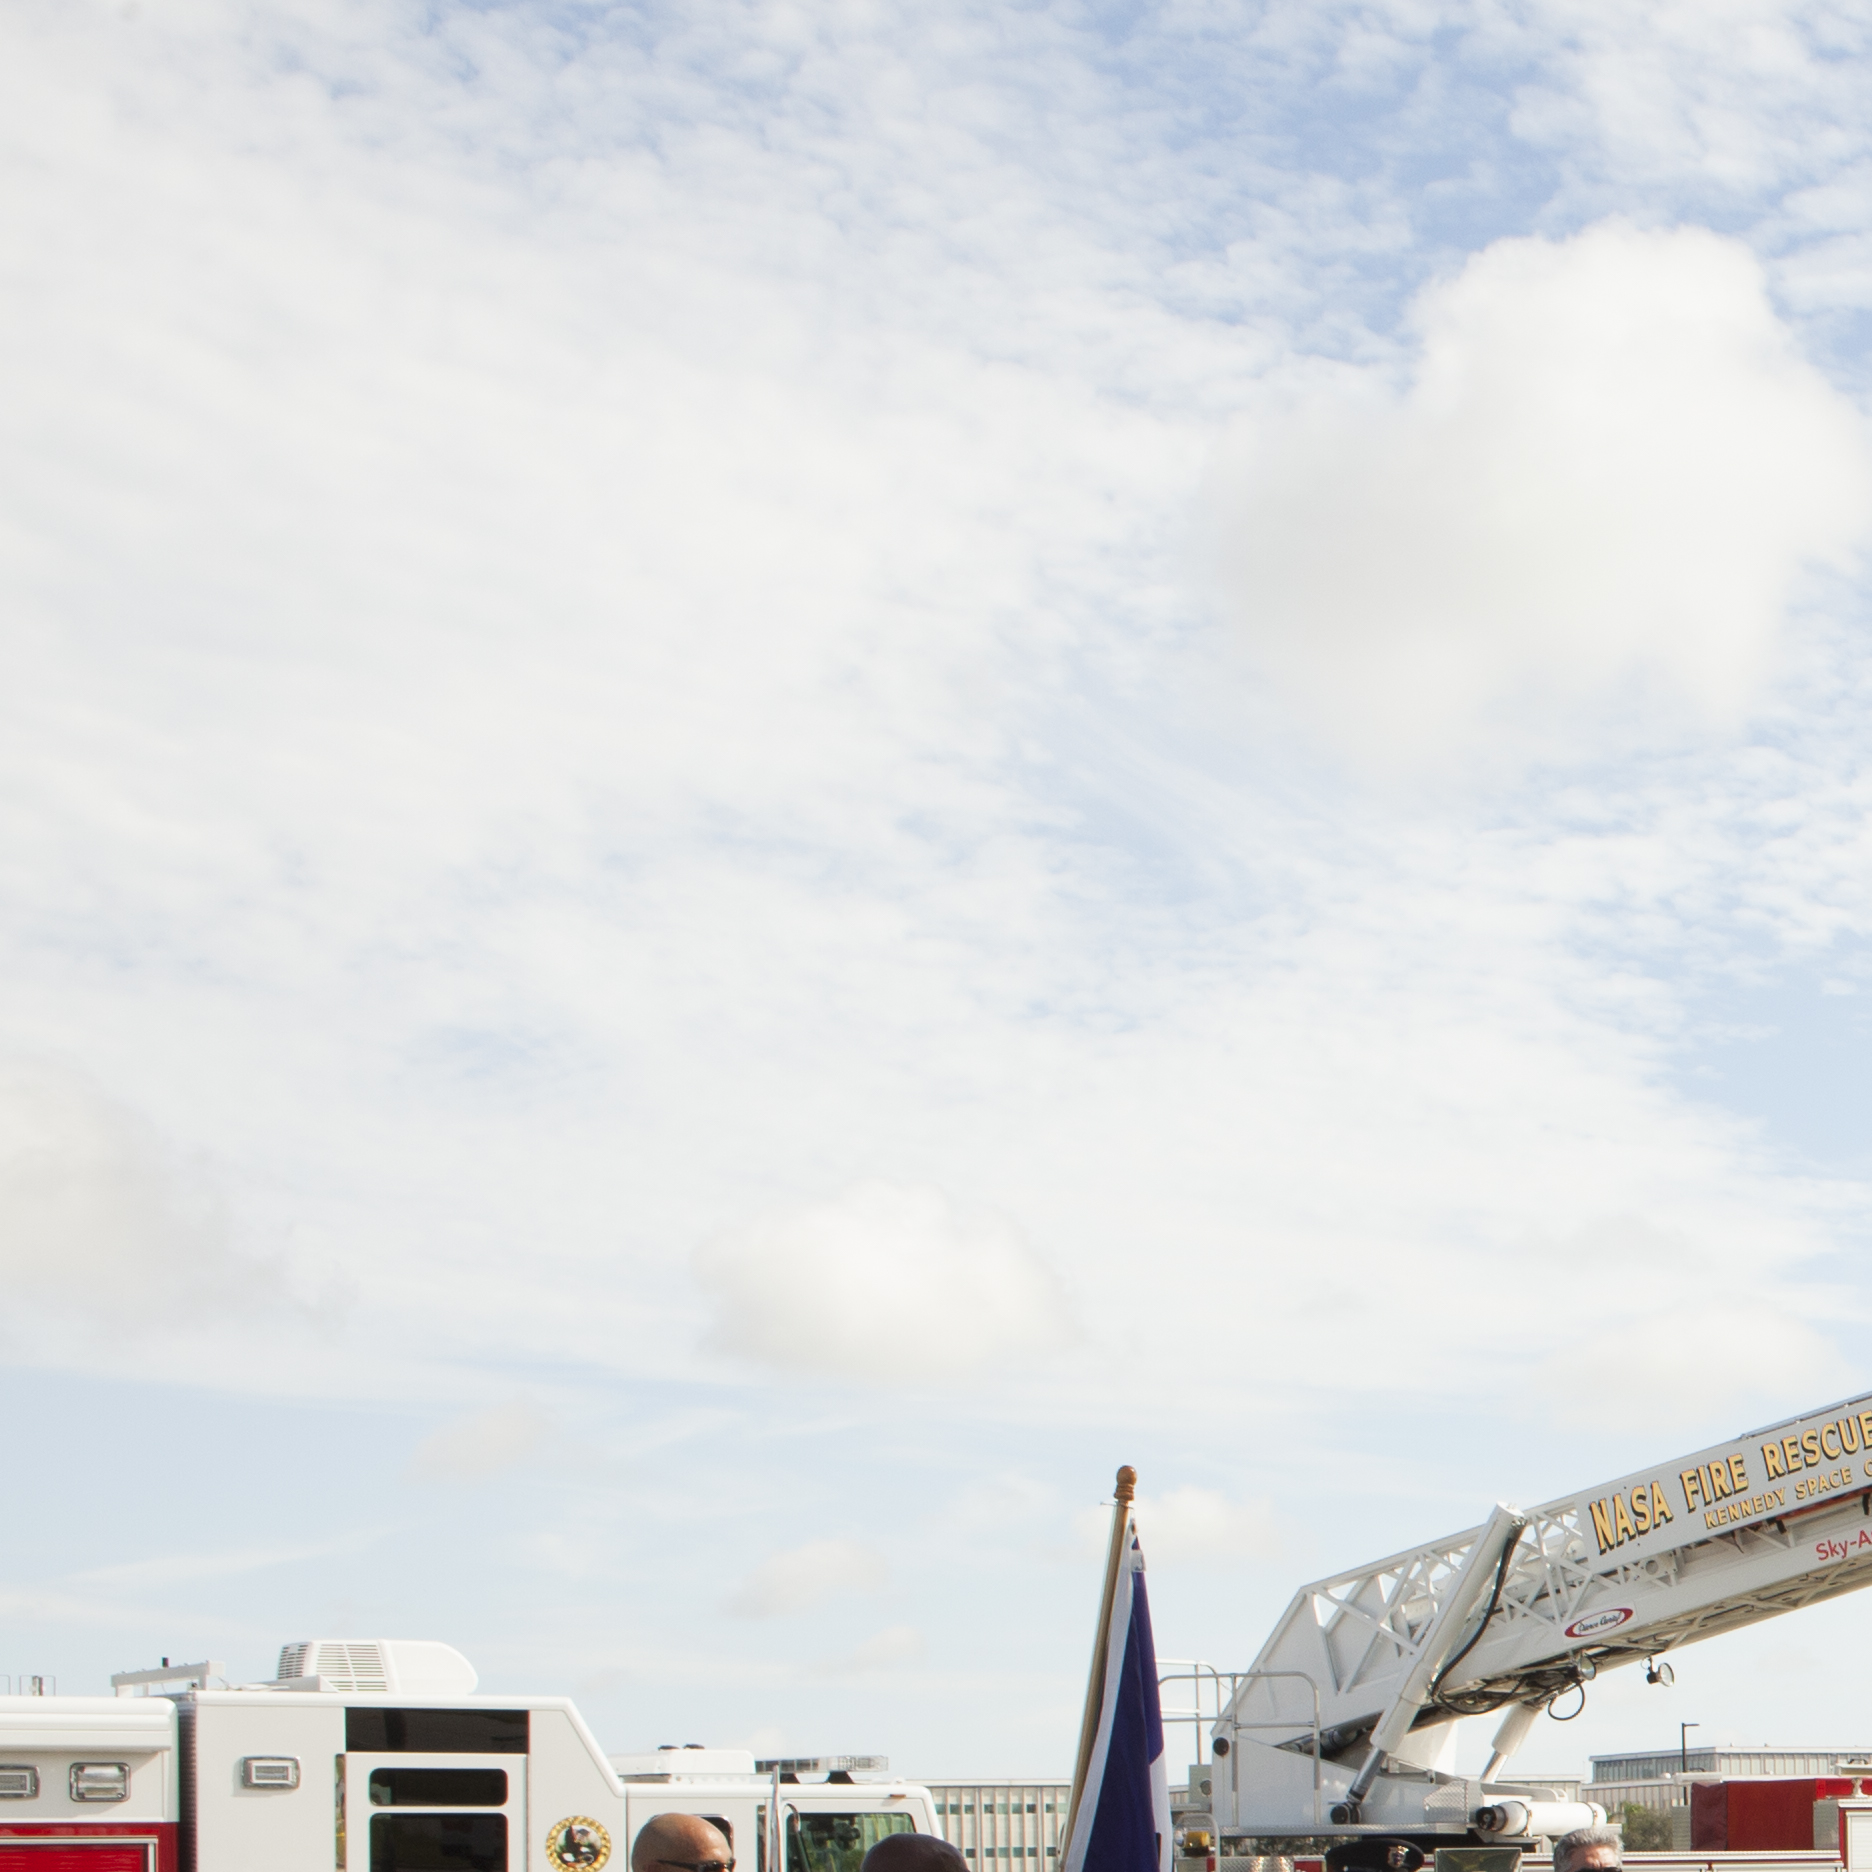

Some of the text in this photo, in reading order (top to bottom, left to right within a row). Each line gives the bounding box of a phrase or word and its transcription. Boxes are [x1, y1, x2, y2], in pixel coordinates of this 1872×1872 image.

[1590, 1481, 1674, 1555] NASA
[1681, 1454, 1749, 1513] FIRE
[1704, 1487, 1788, 1529] KENNEDY
[1795, 1466, 1852, 1500] SPACE
